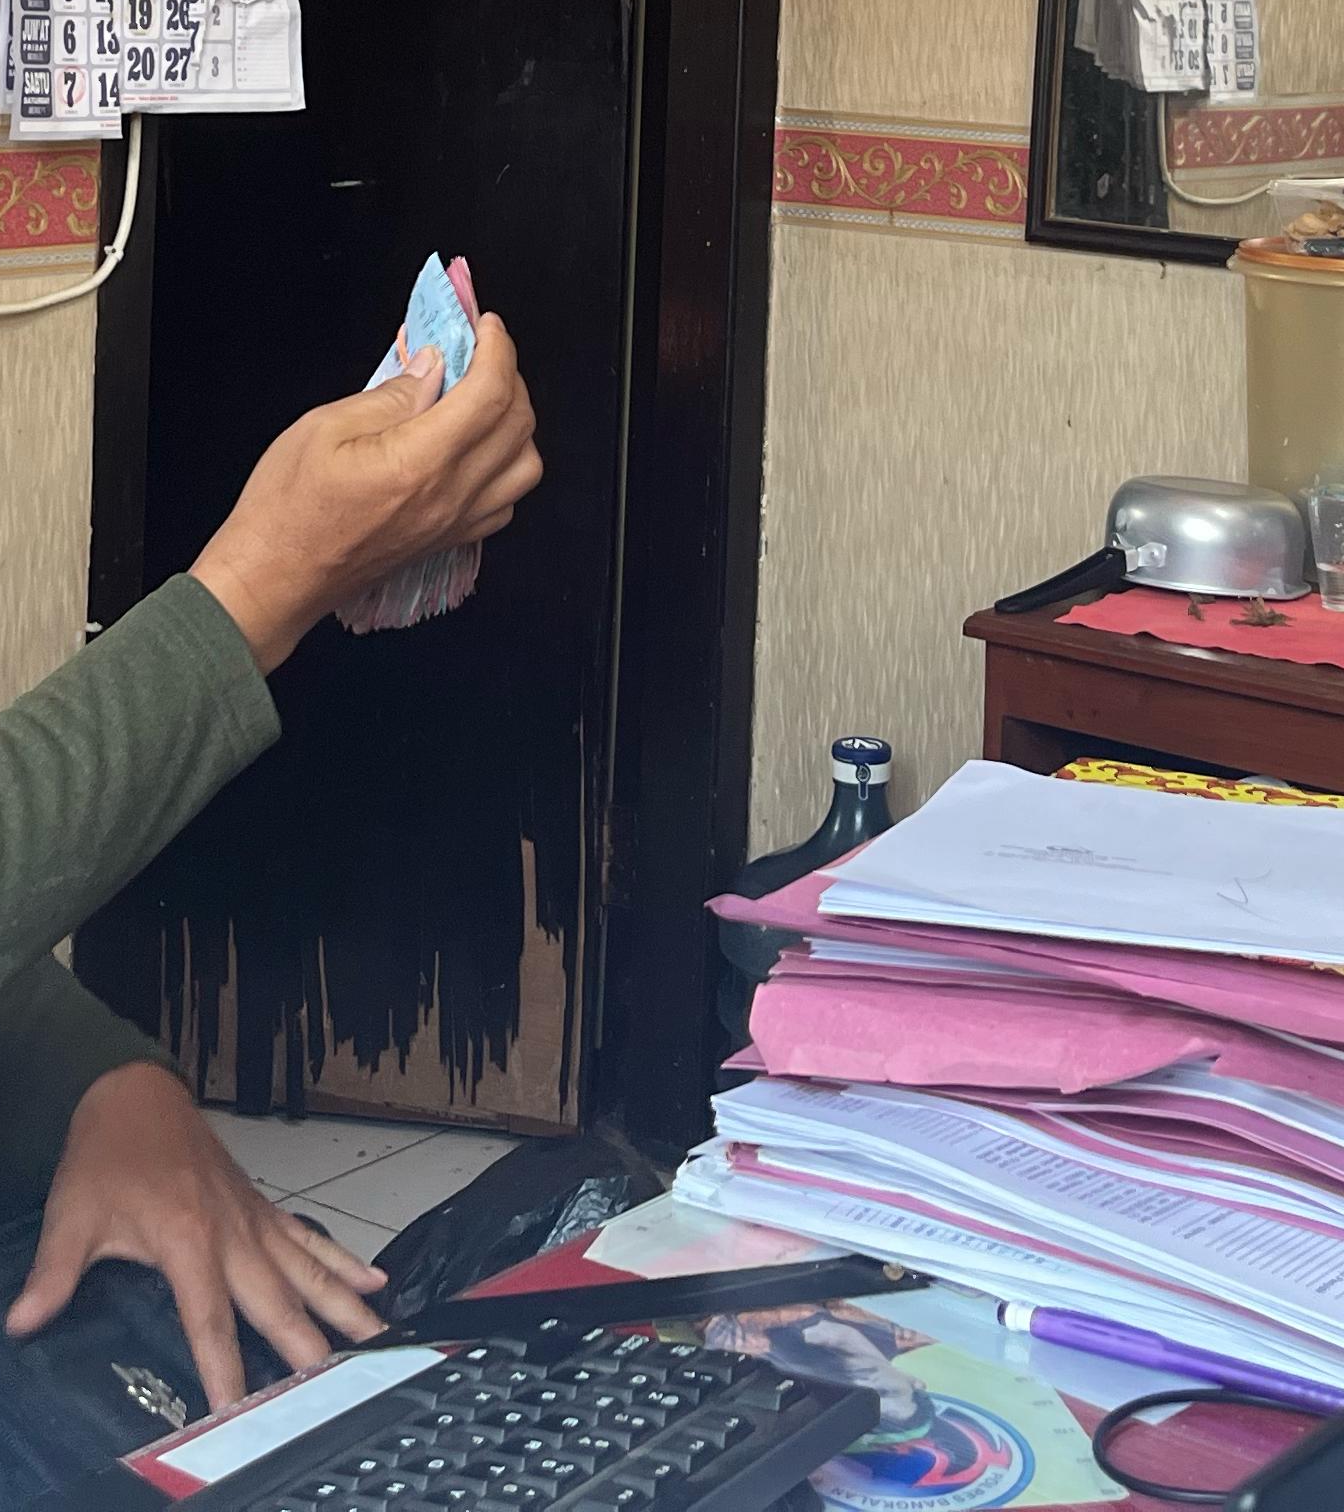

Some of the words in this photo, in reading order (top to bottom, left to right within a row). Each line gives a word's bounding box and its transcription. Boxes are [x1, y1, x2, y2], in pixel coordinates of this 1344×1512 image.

[64, 20, 76, 54] 6
[127, 47, 154, 81] 20
[165, 48, 191, 81] 27
[211, 57, 219, 77] 3
[25, 72, 49, 94] SABTU
[64, 72, 76, 107] 7
[831, 1487, 949, 1510] BANGKALAN
[953, 1472, 1004, 1502] POLRES
